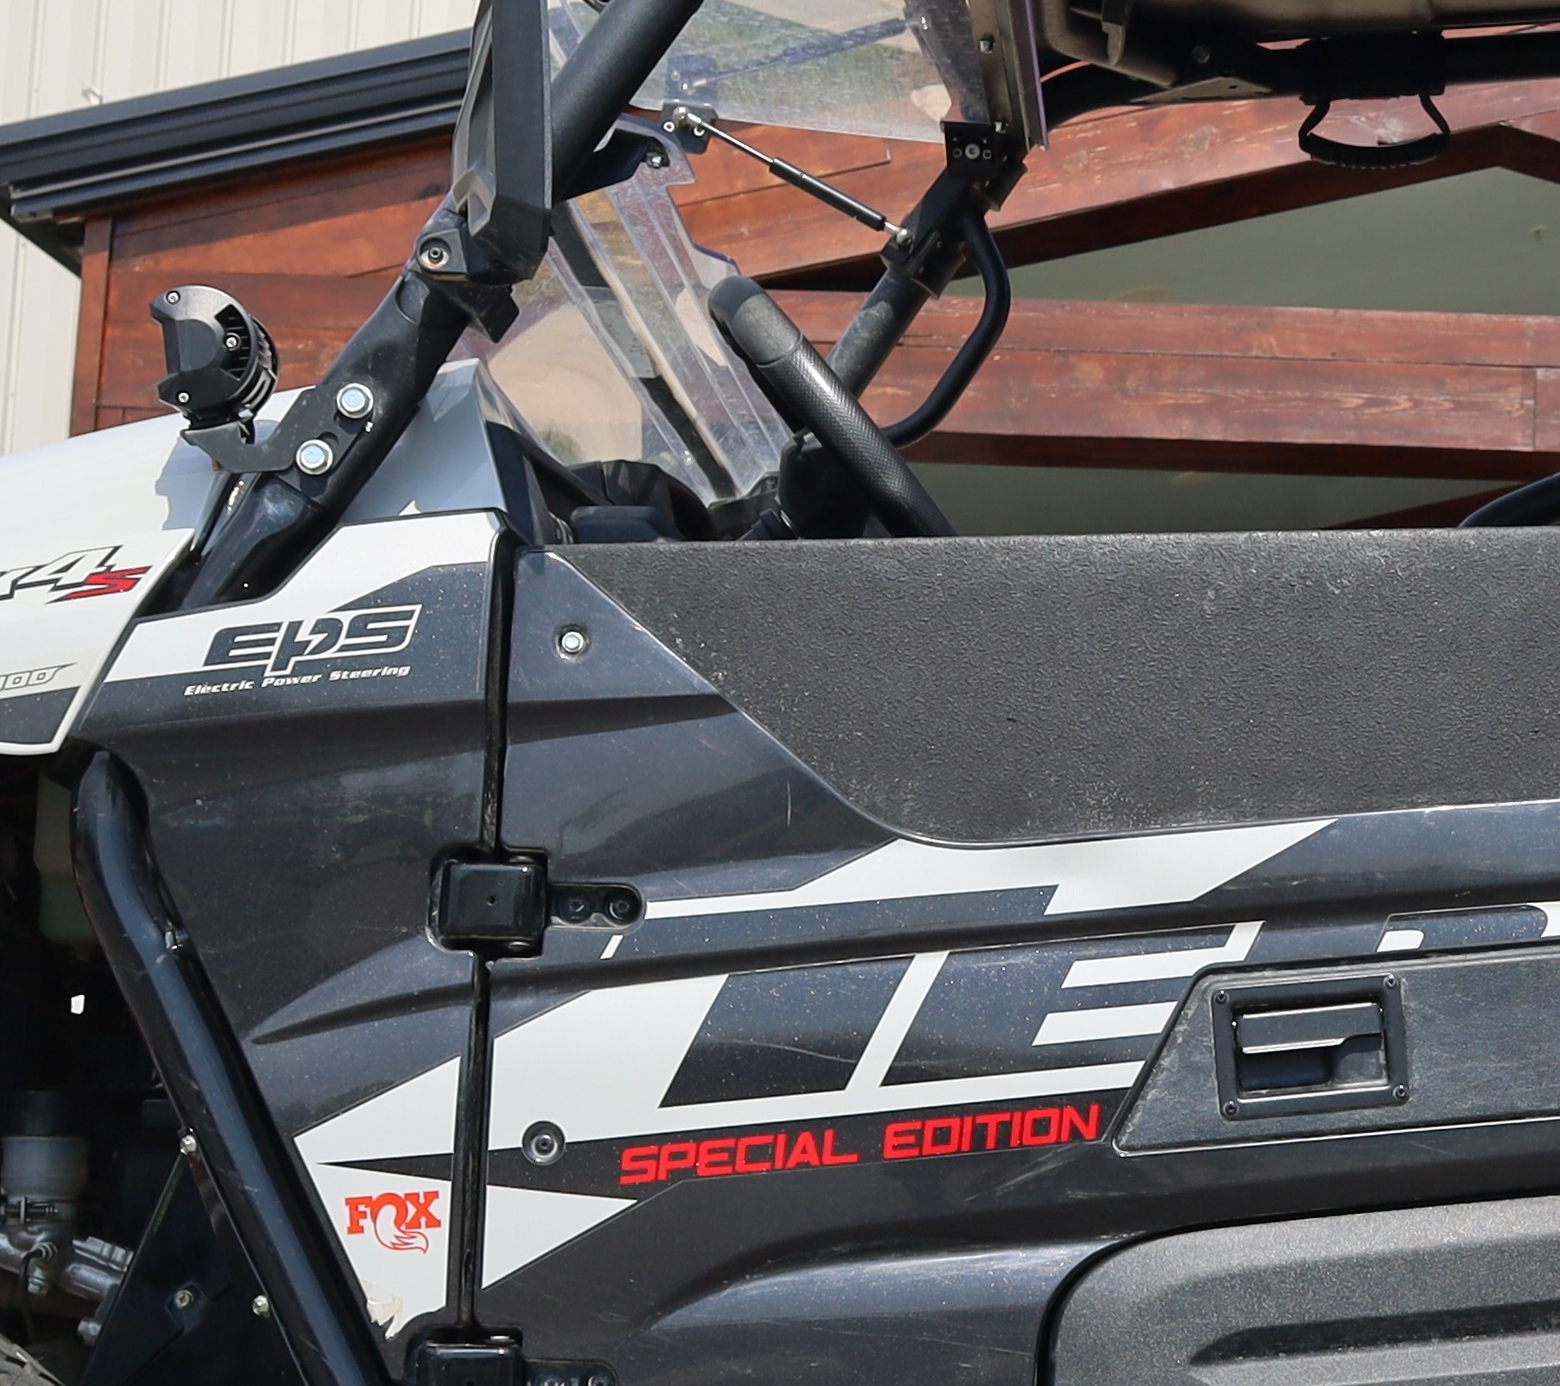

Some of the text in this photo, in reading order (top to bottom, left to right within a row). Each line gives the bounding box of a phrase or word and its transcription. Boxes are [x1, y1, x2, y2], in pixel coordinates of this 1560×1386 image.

[201, 603, 423, 676] EPS
[184, 665, 412, 697] Electric Power Steering
[618, 1103, 1101, 1186] SPECIAL EDITION
[344, 1190, 442, 1254] FOX
